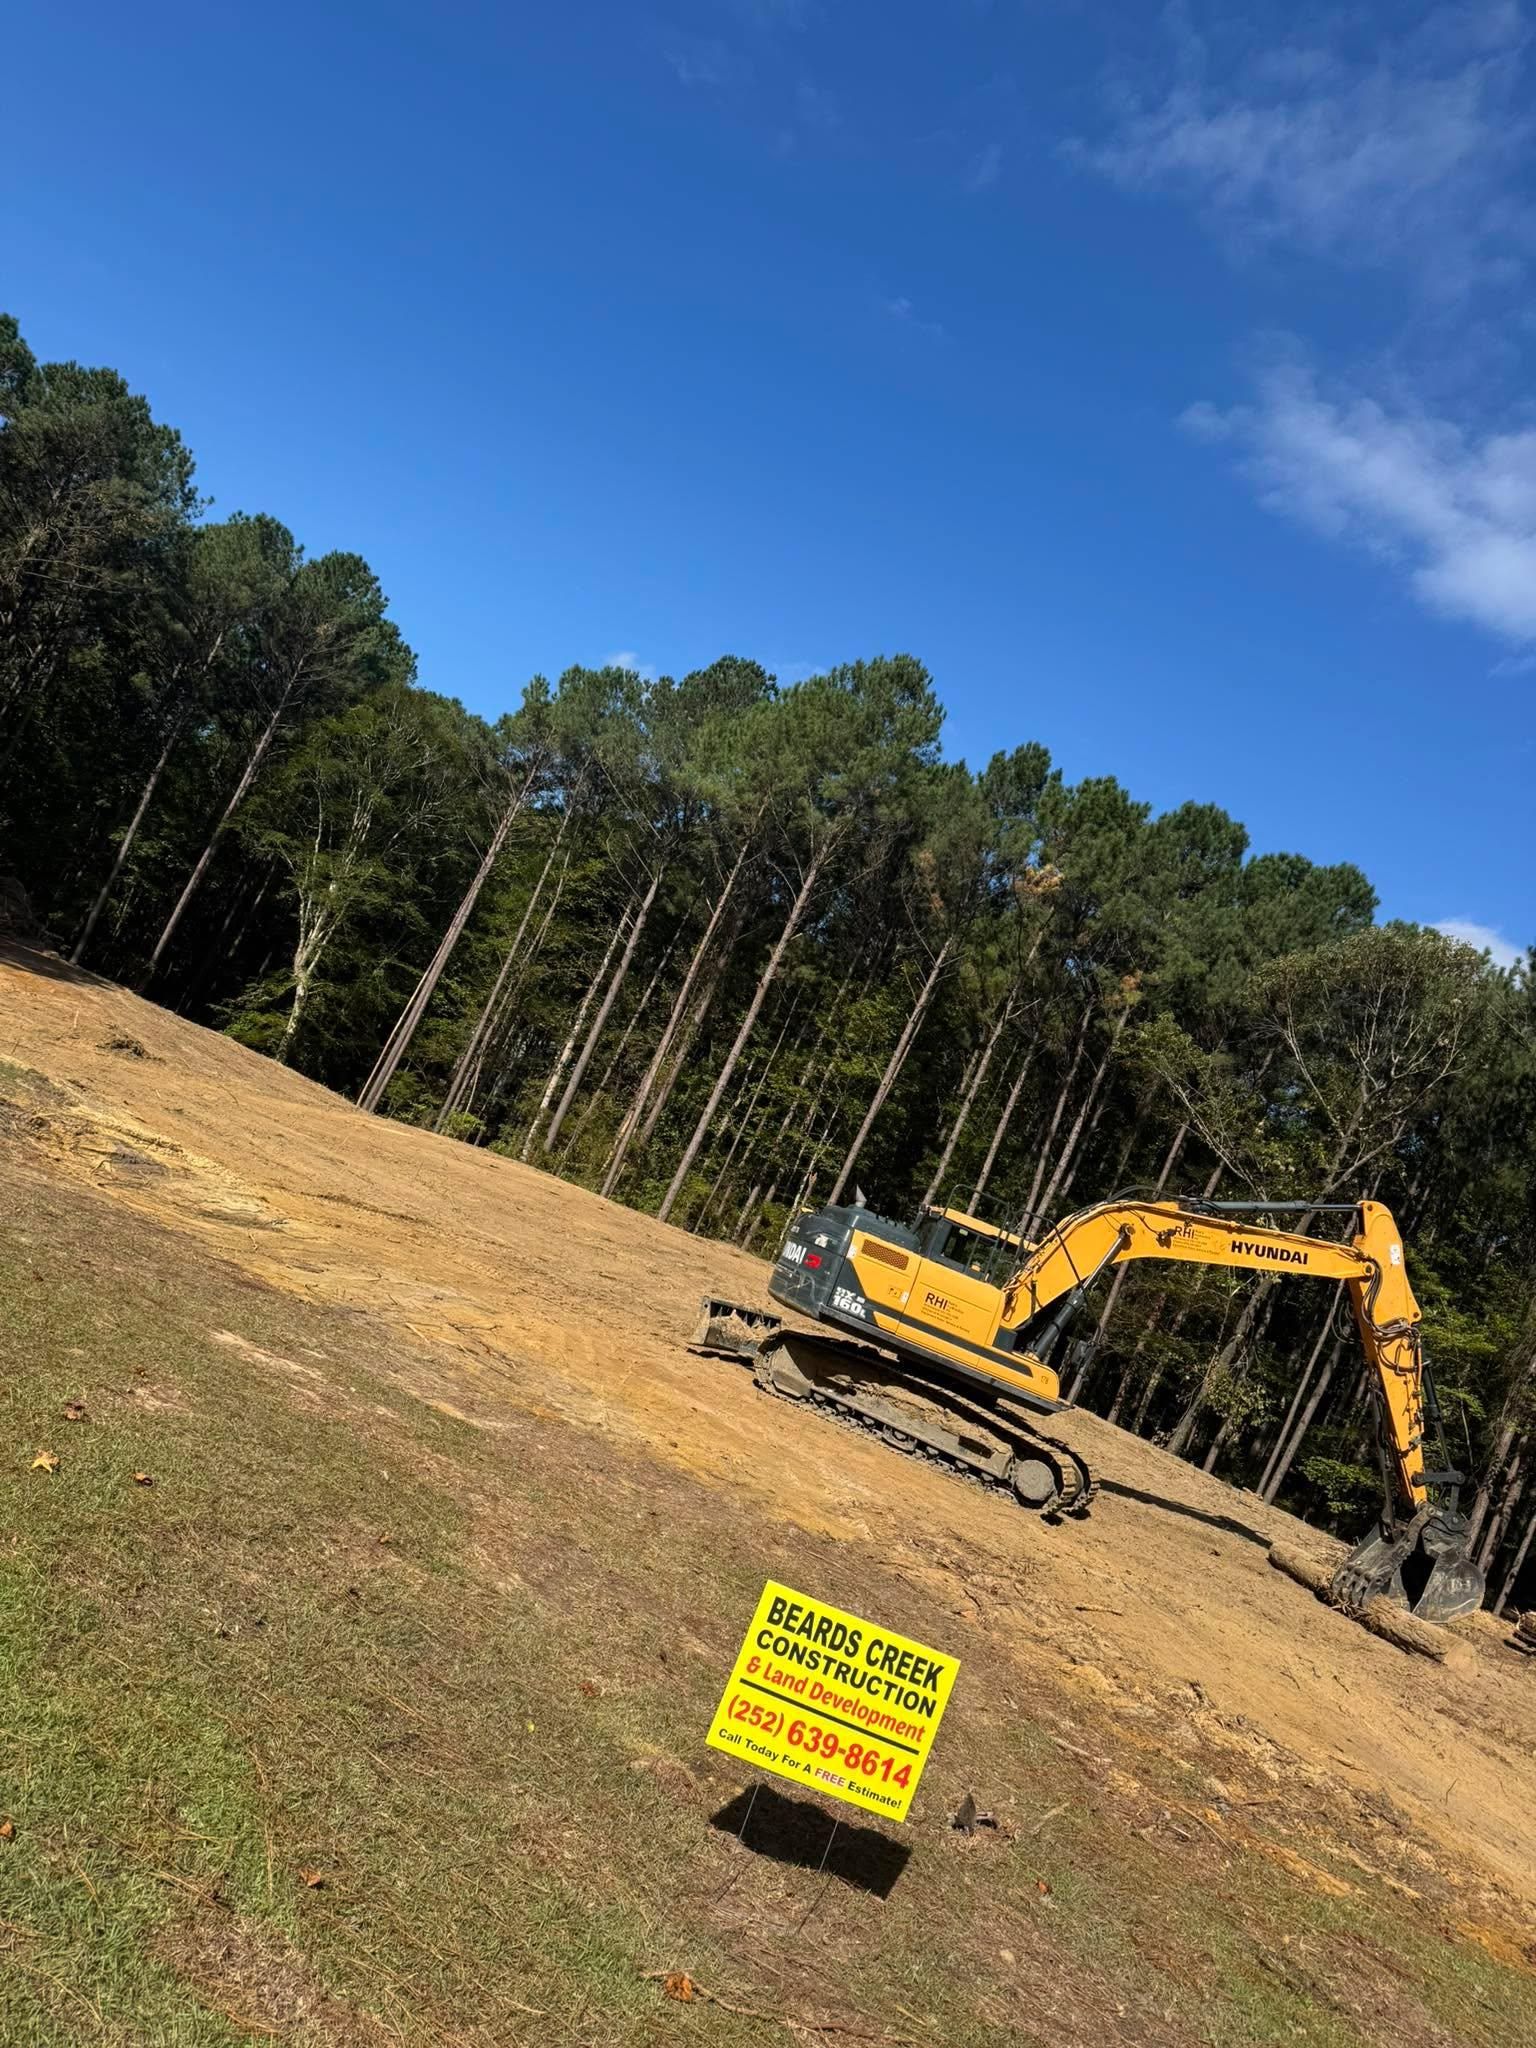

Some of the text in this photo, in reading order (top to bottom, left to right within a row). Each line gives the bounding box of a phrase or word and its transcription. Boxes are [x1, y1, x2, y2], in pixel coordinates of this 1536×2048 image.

[1174, 1226, 1195, 1240] RHI
[1231, 1240, 1309, 1265] HYUNDAI
[925, 1292, 949, 1310] RHI
[756, 1629, 937, 1718] CONSTRUCTION
[766, 1596, 944, 1692] BEARDS CREEK
[746, 1655, 926, 1743] & Land Development
[718, 1728, 903, 1810] Call Today For A FREE Estimate!
[727, 1694, 913, 1790] (252) 639-8614
